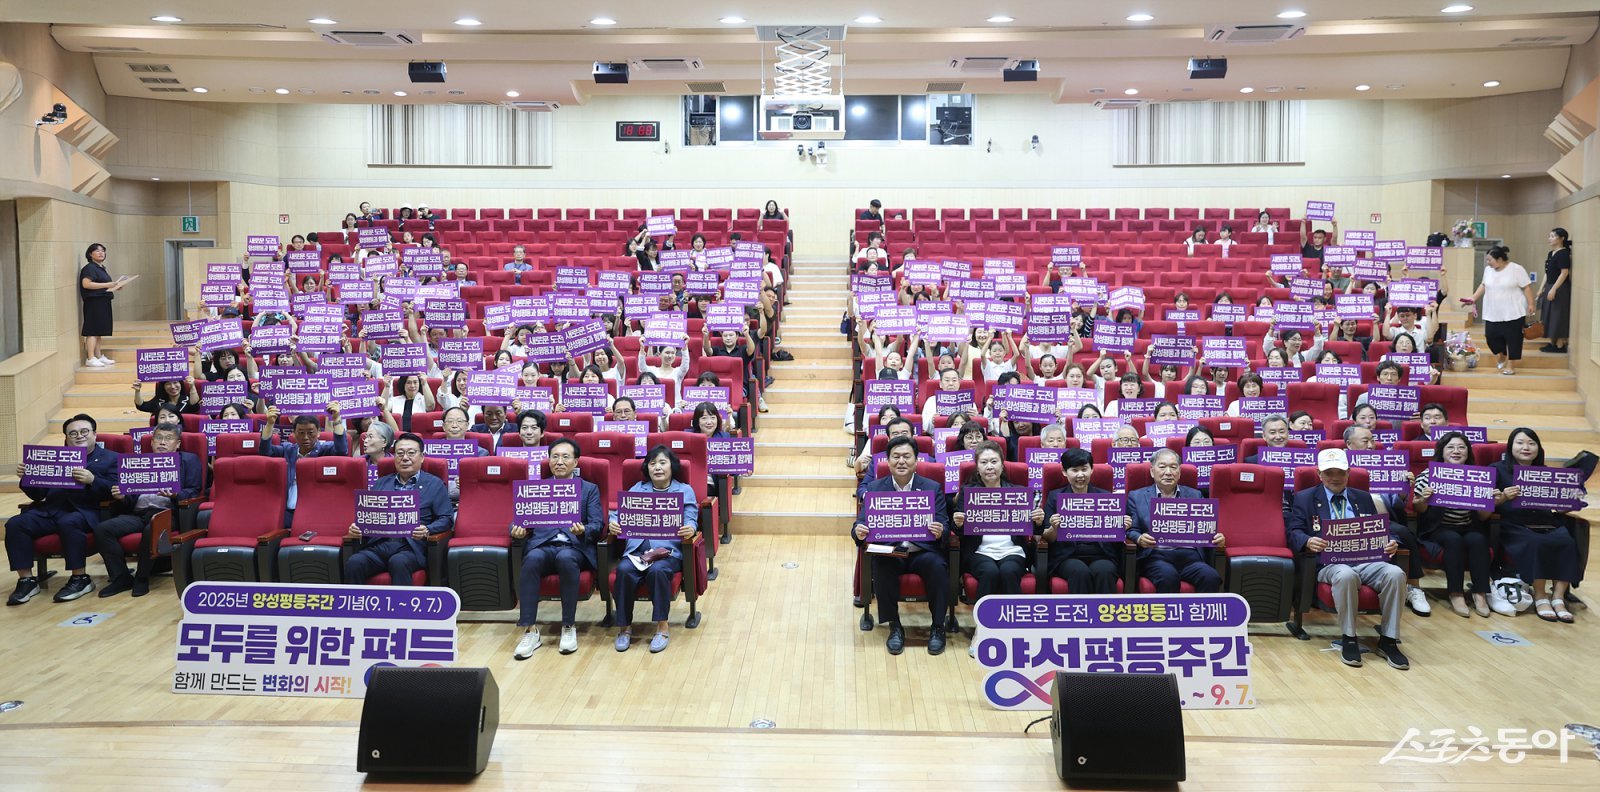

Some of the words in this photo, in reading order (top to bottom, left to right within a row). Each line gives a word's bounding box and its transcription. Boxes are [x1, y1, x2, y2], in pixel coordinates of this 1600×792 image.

[139, 351, 165, 361] 새로운
[138, 363, 171, 373] 양성평등과
[275, 378, 305, 389] 새로운
[469, 373, 495, 383] 새로운
[467, 386, 500, 396] 양성평등과
[564, 387, 586, 395] 새로운
[868, 383, 891, 392] 새로운
[1008, 387, 1034, 399] 새로운
[1370, 387, 1396, 398] 새로운
[275, 393, 312, 404] 양성평등과
[563, 398, 592, 407] 양성평등과
[867, 395, 897, 404] 양성평등과
[1370, 399, 1401, 410] 양성평등과
[1007, 400, 1039, 413] 양성평등과
[26, 449, 56, 461] 새로운
[121, 457, 150, 469] 새로운
[24, 464, 63, 476] 양성평등과
[1432, 466, 1464, 481] 새로운
[1517, 470, 1551, 483] 새로운
[120, 471, 158, 483] 양성평등과
[517, 484, 550, 498] 새로운
[1430, 481, 1472, 497] 양성평등과
[1515, 484, 1558, 498] 양성평등과
[358, 495, 388, 508] 새로운
[621, 497, 652, 510] 새로운
[869, 496, 903, 510] 새로운
[968, 492, 1002, 505] 새로운
[1061, 498, 1094, 511] 새로운
[515, 501, 558, 515] 양성평등과
[1154, 502, 1187, 516] 새로운
[357, 511, 396, 524] 양성평등과
[618, 513, 660, 526] 양성평등과
[866, 514, 911, 528] 양성평등과
[966, 509, 1009, 522] 양성평등과
[1058, 515, 1102, 528] 양성평등과
[1152, 519, 1195, 533] 양성평등과
[1326, 522, 1359, 536] 새로운
[1323, 537, 1368, 552] 양성평등과
[198, 591, 249, 608] 2025년
[252, 592, 335, 610] 양성평등주간
[998, 604, 1049, 622] 새로운
[1054, 604, 1093, 624] 도전,
[1098, 603, 1184, 622] 양성평등과
[1189, 602, 1228, 622] 함께!
[177, 623, 278, 665] 모두를
[285, 625, 355, 666] 위한
[175, 672, 205, 690] 함께
[211, 673, 257, 691] 만드는
[262, 675, 309, 693] 변화의
[314, 676, 352, 694] 시작!
